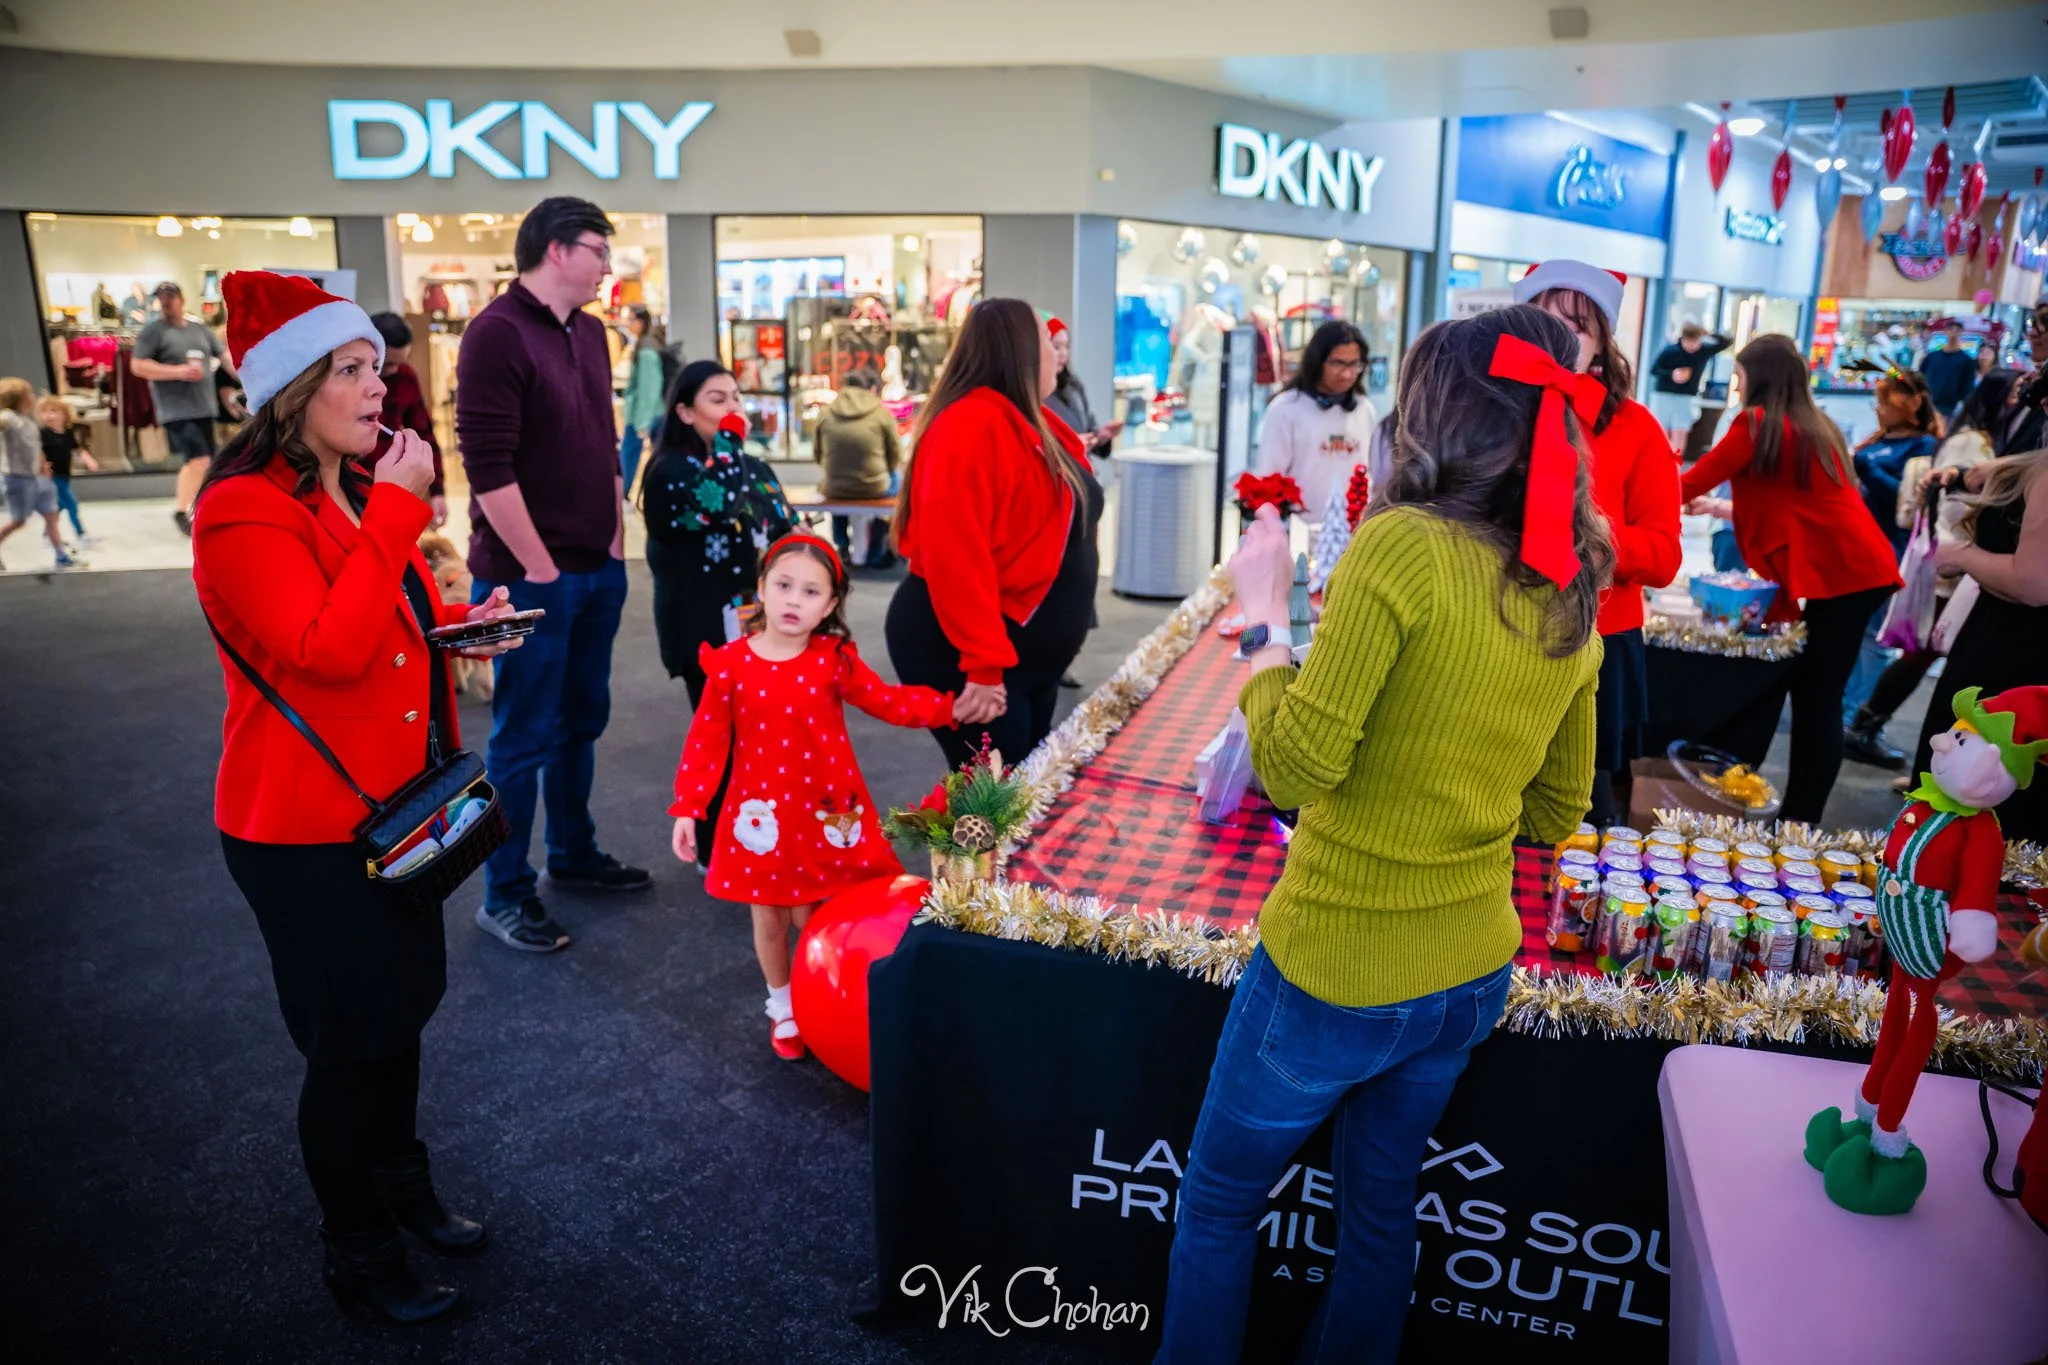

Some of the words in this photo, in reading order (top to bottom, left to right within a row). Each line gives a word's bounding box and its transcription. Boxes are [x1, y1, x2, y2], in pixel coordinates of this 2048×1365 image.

[328, 99, 714, 179] DKNY
[1218, 122, 1385, 214] DKNY
[1093, 1128, 1191, 1178] LA
[1431, 1298, 1576, 1340] CENTER
